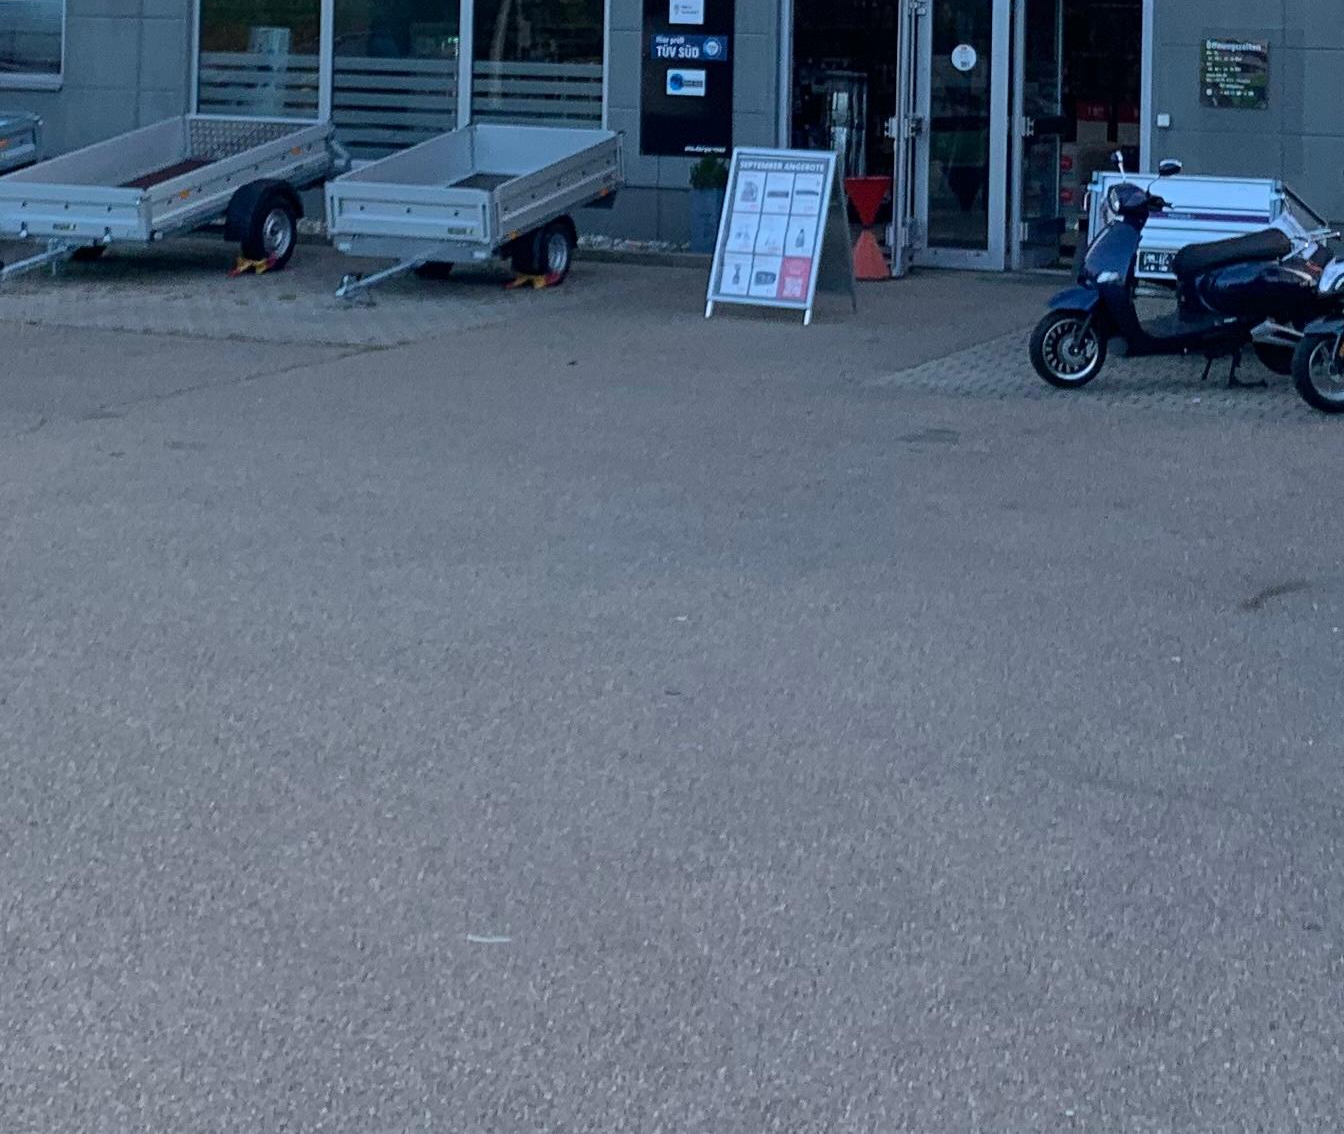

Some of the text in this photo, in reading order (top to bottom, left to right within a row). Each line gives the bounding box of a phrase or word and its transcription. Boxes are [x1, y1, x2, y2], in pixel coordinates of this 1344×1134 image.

[656, 44, 700, 59] TÜV SÜD
[739, 160, 825, 173] SEPTEMBER ANGEBOTE
